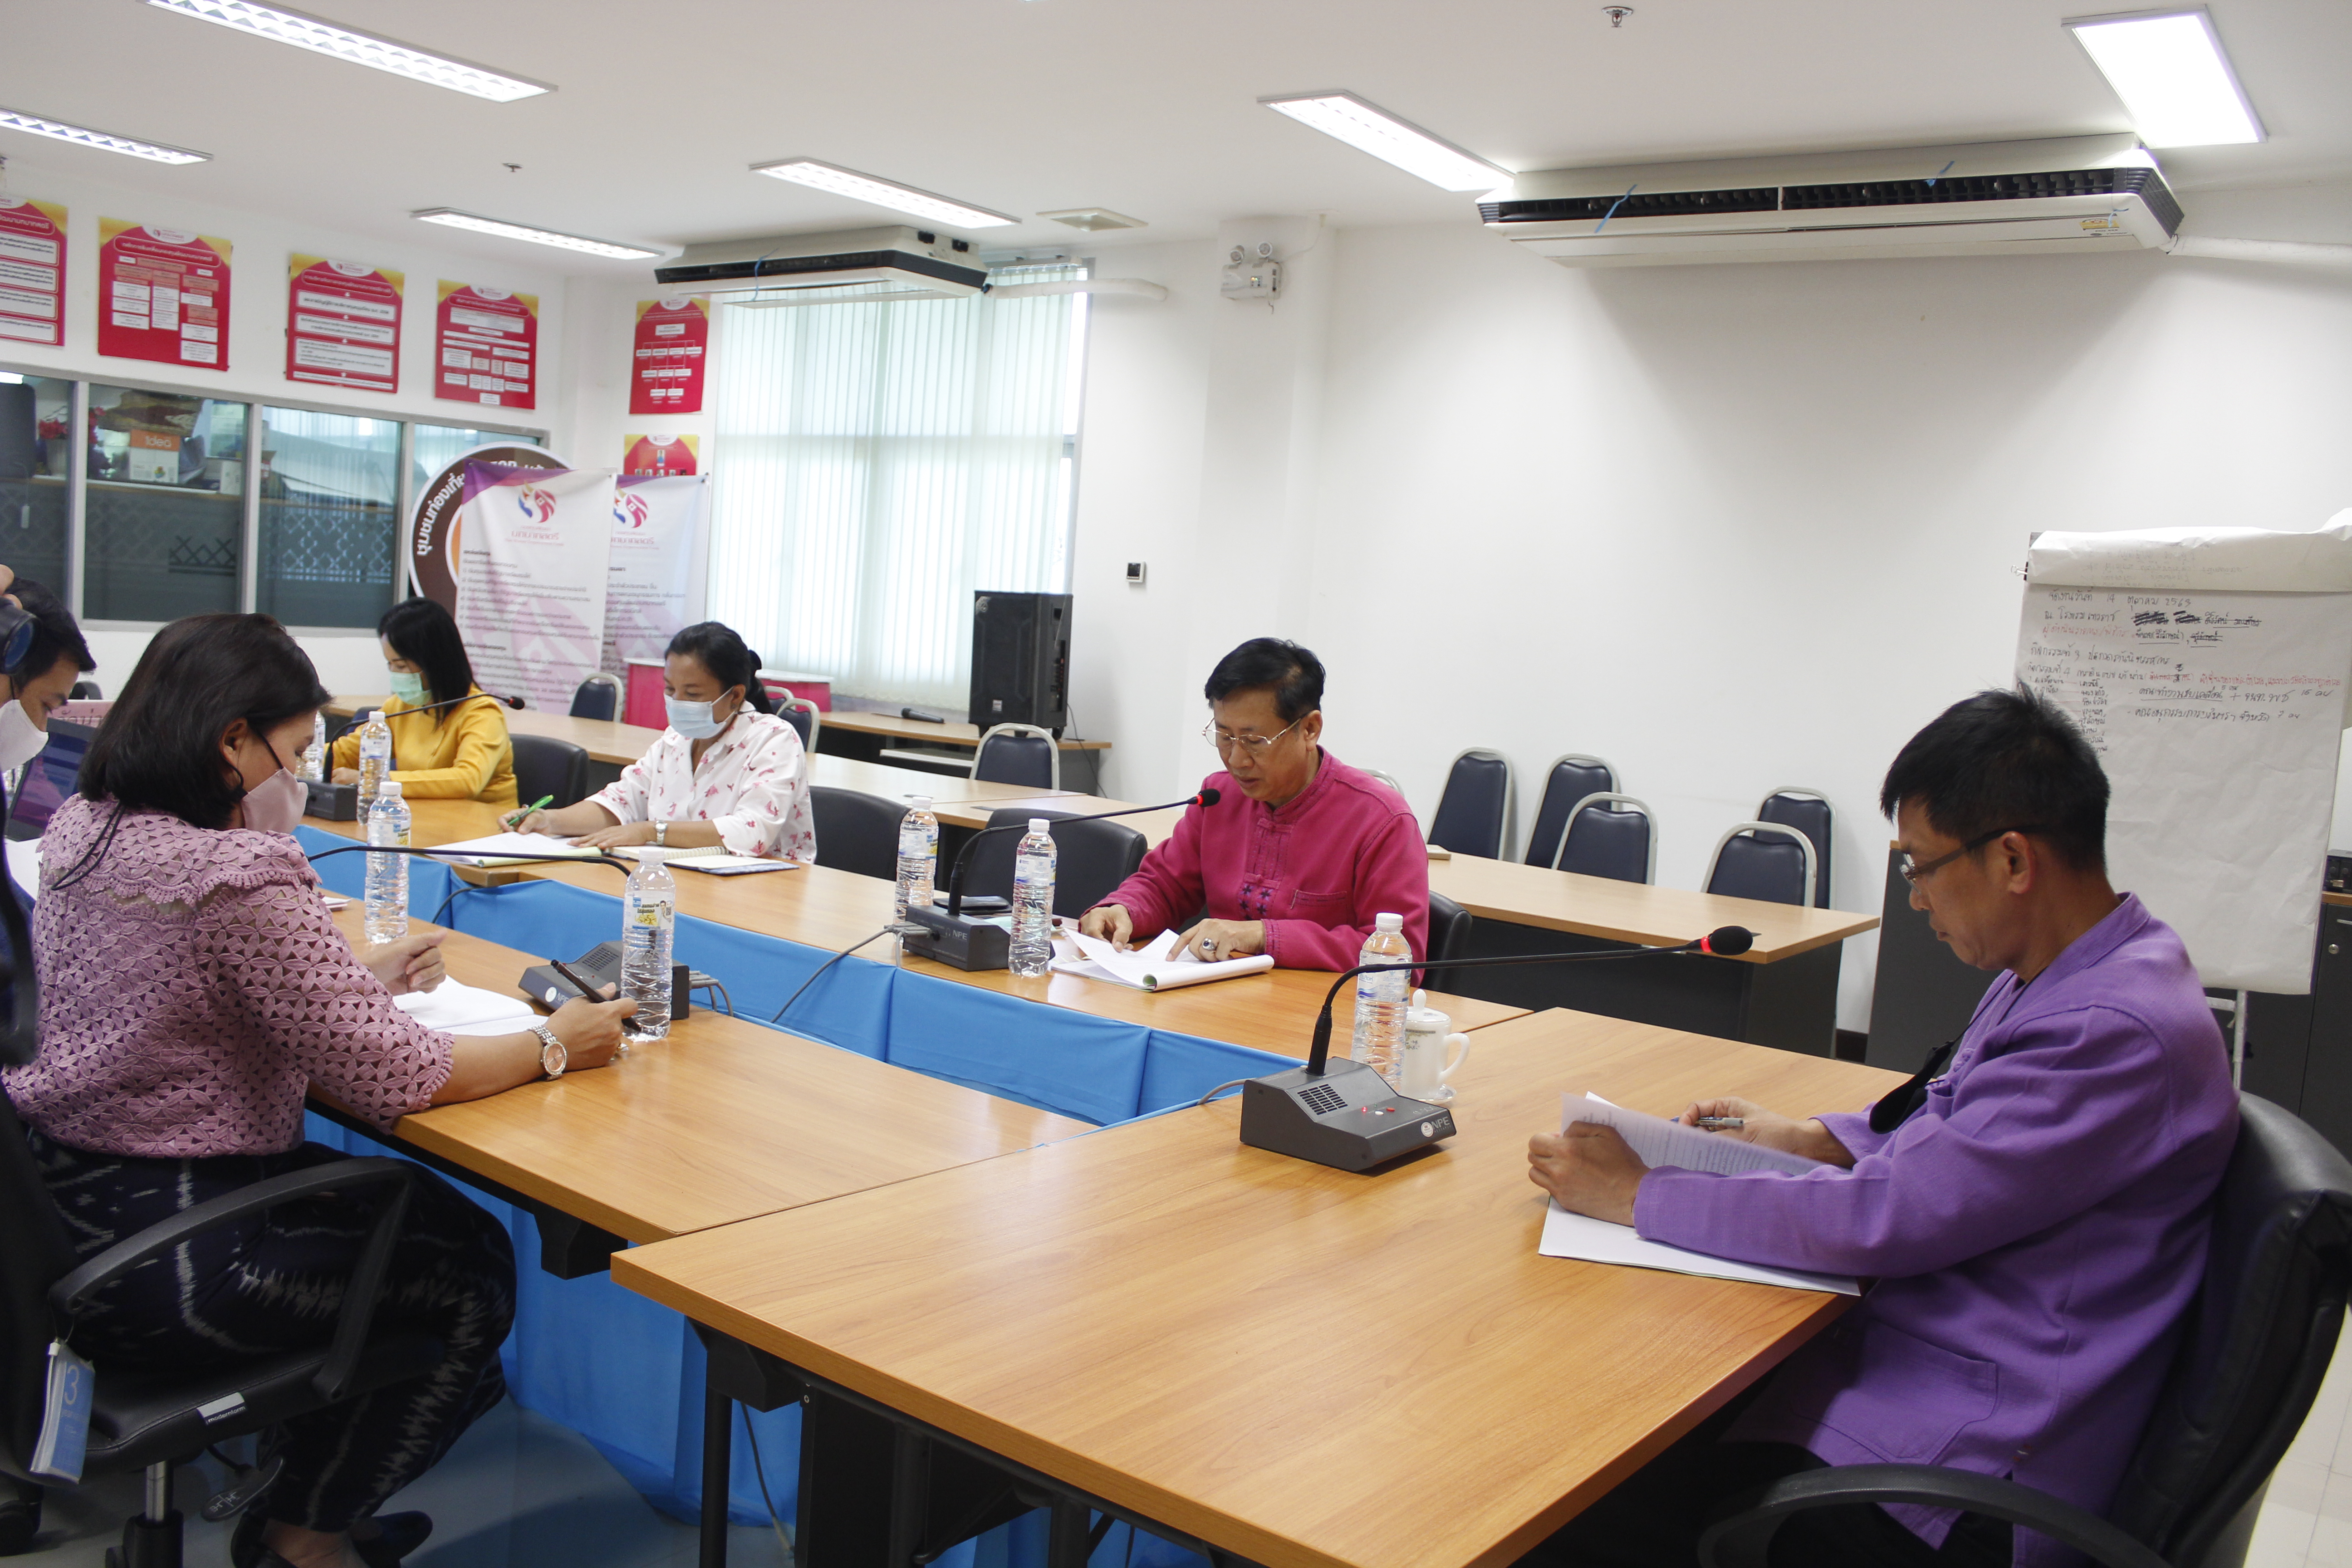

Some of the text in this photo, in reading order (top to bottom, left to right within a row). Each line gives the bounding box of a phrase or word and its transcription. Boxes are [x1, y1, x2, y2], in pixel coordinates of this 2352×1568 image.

[416, 472, 466, 556] ชุมชนท่องเที่ย
[2165, 597, 2191, 607] 2563
[953, 929, 968, 941] NPE
[1431, 1116, 1450, 1130] NPE
[64, 1364, 79, 1405] 3
[208, 1406, 246, 1423] modernform
